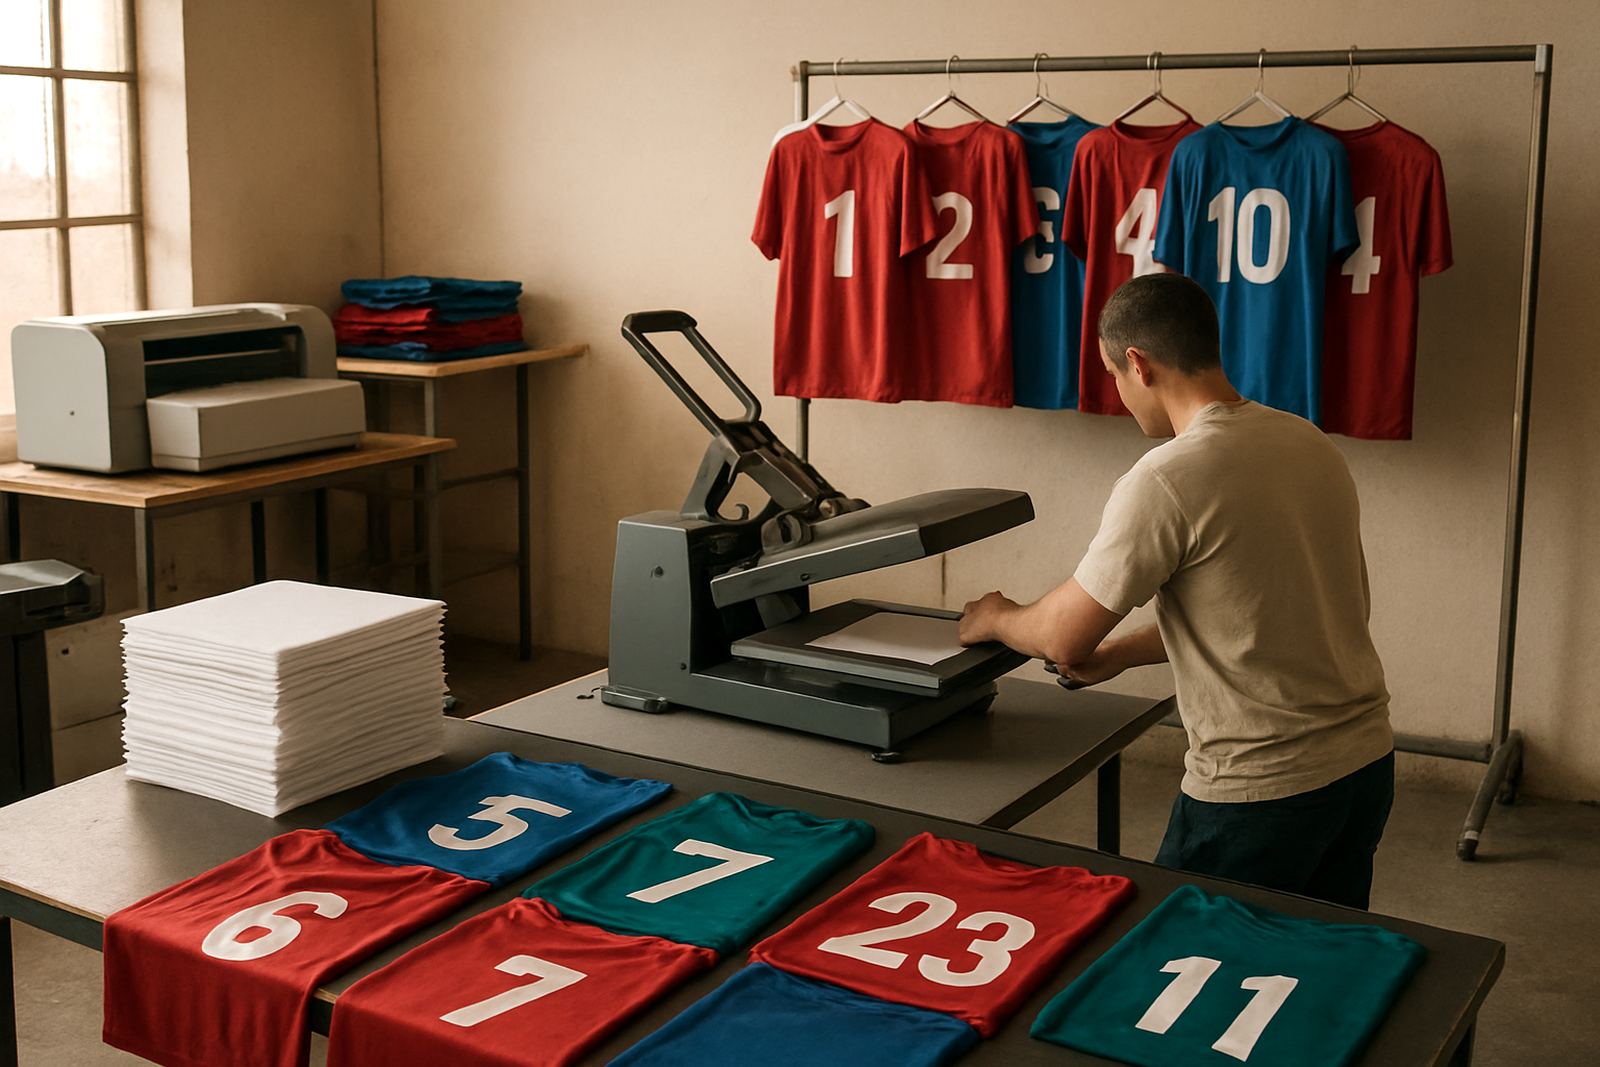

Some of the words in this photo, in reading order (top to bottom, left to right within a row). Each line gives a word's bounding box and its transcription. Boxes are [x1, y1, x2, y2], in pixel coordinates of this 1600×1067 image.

[824, 189, 855, 278] 1
[926, 191, 974, 280] 2
[1115, 188, 1165, 279] 4
[1206, 186, 1292, 285] 10
[427, 794, 573, 851] 5
[625, 838, 775, 904] 7
[201, 890, 349, 962] 6
[816, 890, 1037, 988] 23
[439, 954, 589, 1028] 7
[1134, 955, 1300, 1063] 11
